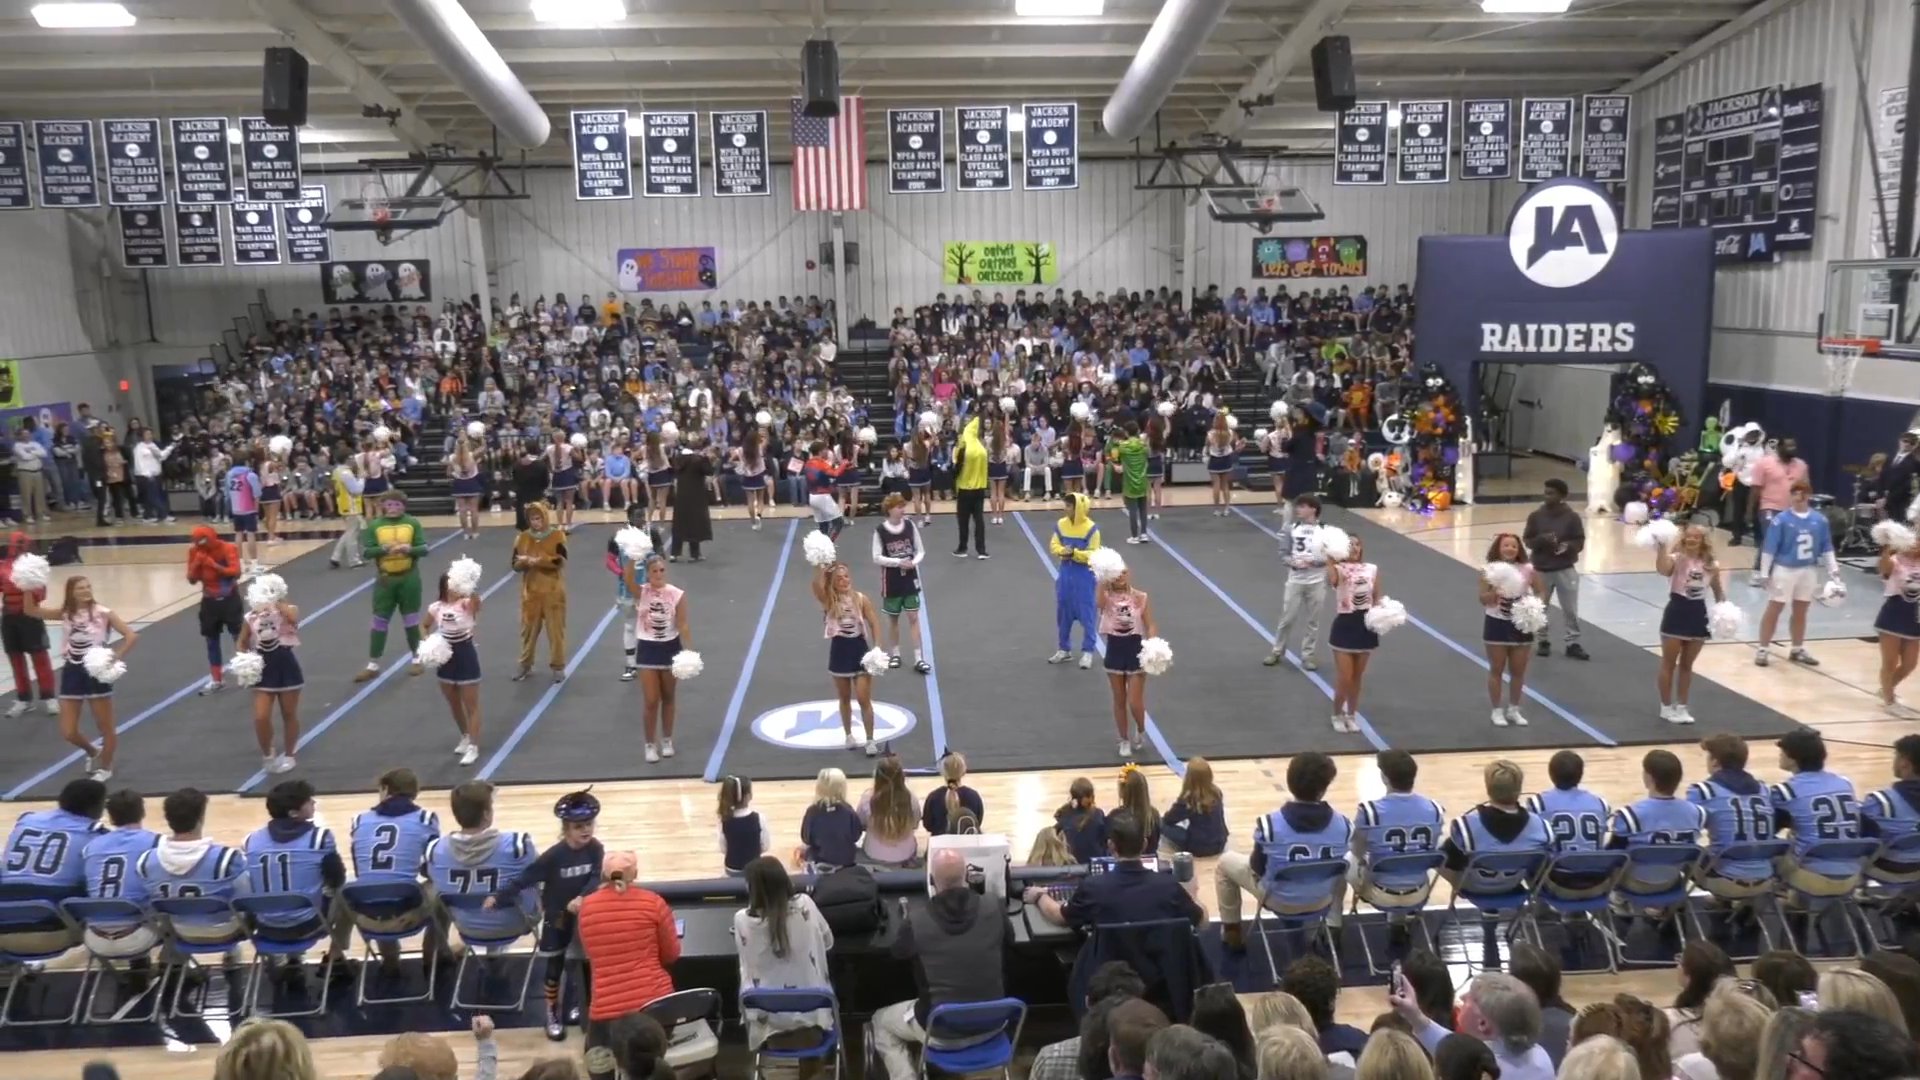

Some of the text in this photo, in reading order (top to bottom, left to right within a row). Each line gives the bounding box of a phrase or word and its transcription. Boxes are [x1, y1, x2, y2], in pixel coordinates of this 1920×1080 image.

[1707, 92, 1760, 116] JACKSON
[896, 112, 934, 122] JACKSON
[964, 110, 1001, 119] JACKSON
[1031, 107, 1069, 117] JACKSON
[1529, 112, 1566, 120] ACADEMY
[580, 114, 619, 124] JACKSON
[650, 115, 689, 125] JACKSON
[720, 114, 757, 124] JACKSON
[1031, 118, 1070, 128] ACADEMY
[1344, 116, 1382, 125] ACADEMY
[1406, 114, 1443, 123] ACADEMY
[1704, 108, 1760, 132] ACADEMY
[42, 124, 82, 134] JACKSON
[110, 122, 151, 132] JACKSON
[179, 120, 219, 130] JACKSON
[581, 124, 620, 134] ACADEMY
[720, 124, 758, 134] ACADEMY
[896, 123, 935, 133] ACADEMY
[964, 120, 1002, 130] ACADEMY
[180, 132, 221, 142] ACADEMY
[250, 132, 290, 141] ACADEMY
[650, 127, 690, 137] ACADEMY
[43, 136, 84, 146] ACADEMY
[111, 132, 152, 143] ACADEMY
[892, 162, 914, 170] CLASS
[896, 171, 936, 180] CHAMPIONS
[965, 170, 1004, 178] CHAMPIONS
[1031, 168, 1070, 177] CHAMPIONS
[253, 181, 294, 189] CHAMPIONS
[583, 179, 624, 188] CHAMPIONS
[652, 176, 692, 184] CHAMPIONS
[722, 178, 762, 186] CHAMPIONS
[1042, 178, 1060, 186] 2007
[183, 183, 226, 191] CHAMPIONS
[1526, 204, 1608, 270] JA
[1480, 322, 1636, 352] RAIDERS
[1796, 534, 1814, 560] 2
[1728, 797, 1775, 841] 16
[1811, 794, 1860, 839] 25
[1552, 812, 1599, 850] 29
[6, 828, 71, 876] 50
[371, 823, 400, 871] 2
[100, 854, 128, 898] 8
[260, 852, 292, 892] 11
